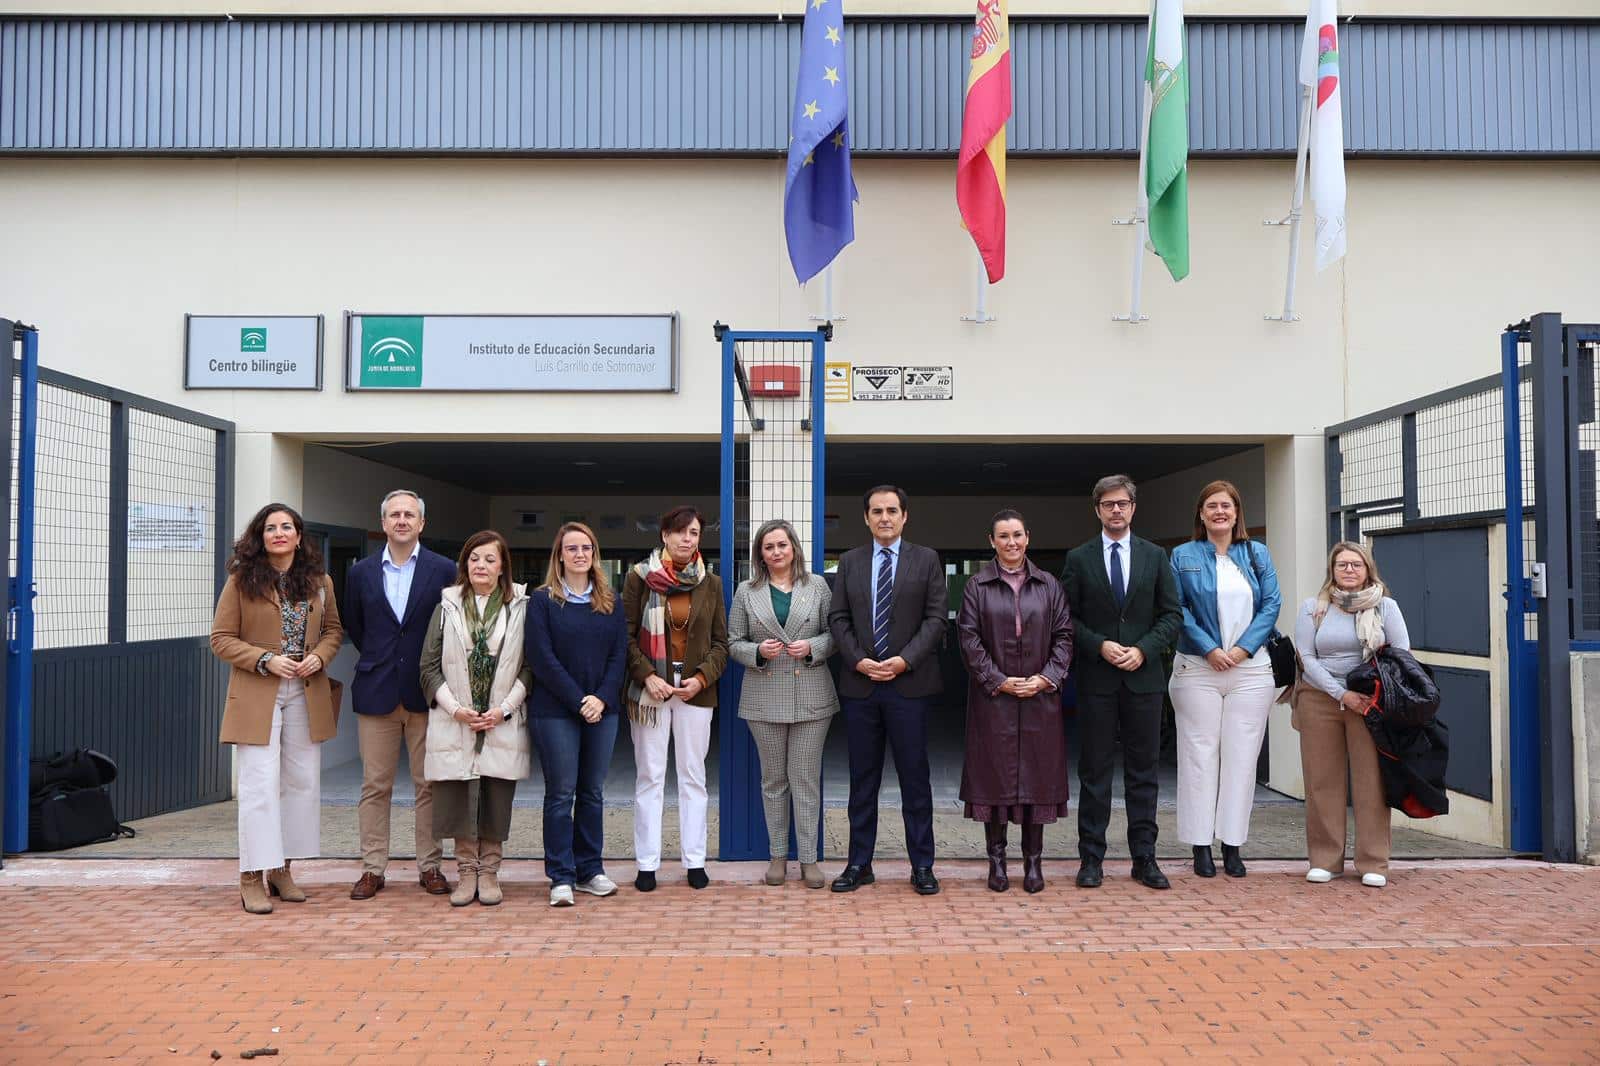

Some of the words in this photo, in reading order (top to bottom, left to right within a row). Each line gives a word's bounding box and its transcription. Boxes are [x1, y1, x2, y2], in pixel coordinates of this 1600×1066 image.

[469, 343, 514, 355] Instituto
[517, 343, 530, 355] de
[534, 343, 590, 355] Educación
[593, 343, 655, 355] Secundaria
[209, 359, 248, 372] Centro
[251, 359, 297, 375] bilingüe
[535, 360, 554, 372] Luis
[556, 360, 589, 372] Carrillo
[592, 360, 603, 372] de
[606, 360, 656, 375] Sotomayor
